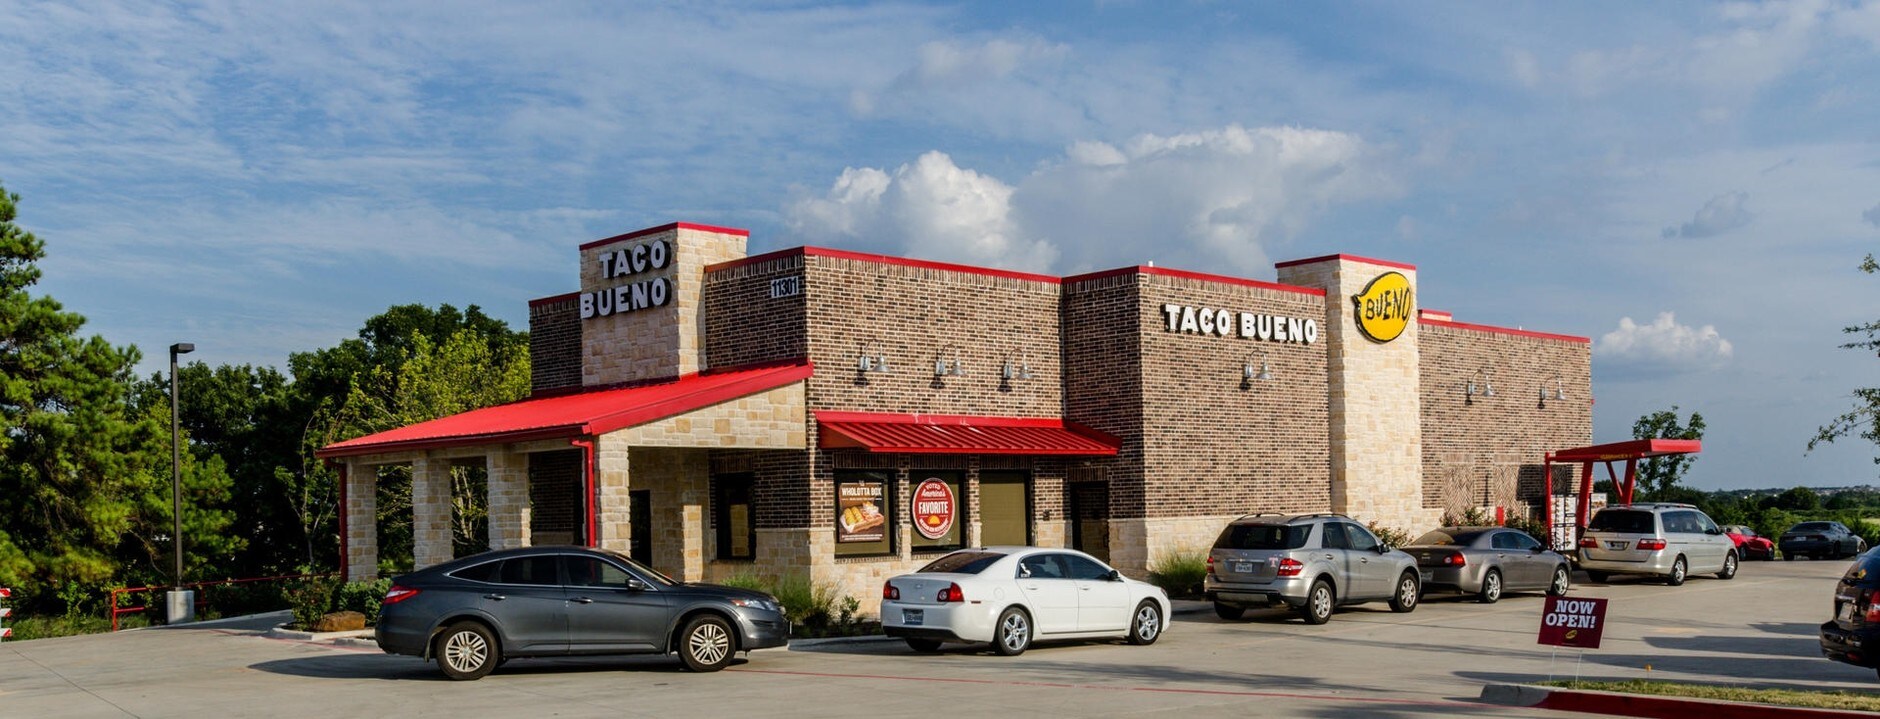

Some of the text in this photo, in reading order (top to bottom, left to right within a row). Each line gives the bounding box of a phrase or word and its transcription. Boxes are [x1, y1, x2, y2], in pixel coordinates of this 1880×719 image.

[600, 240, 666, 279] TACO
[772, 277, 797, 297] 11301
[579, 277, 668, 319] BUENO
[1366, 287, 1411, 321] BUENO
[1164, 304, 1317, 343] TACO BUENO
[842, 487, 882, 496] WHOLOTTA BOX
[918, 501, 948, 514] FAVORITE
[1555, 600, 1596, 614] NOW
[1545, 613, 1596, 628] OPEN!
